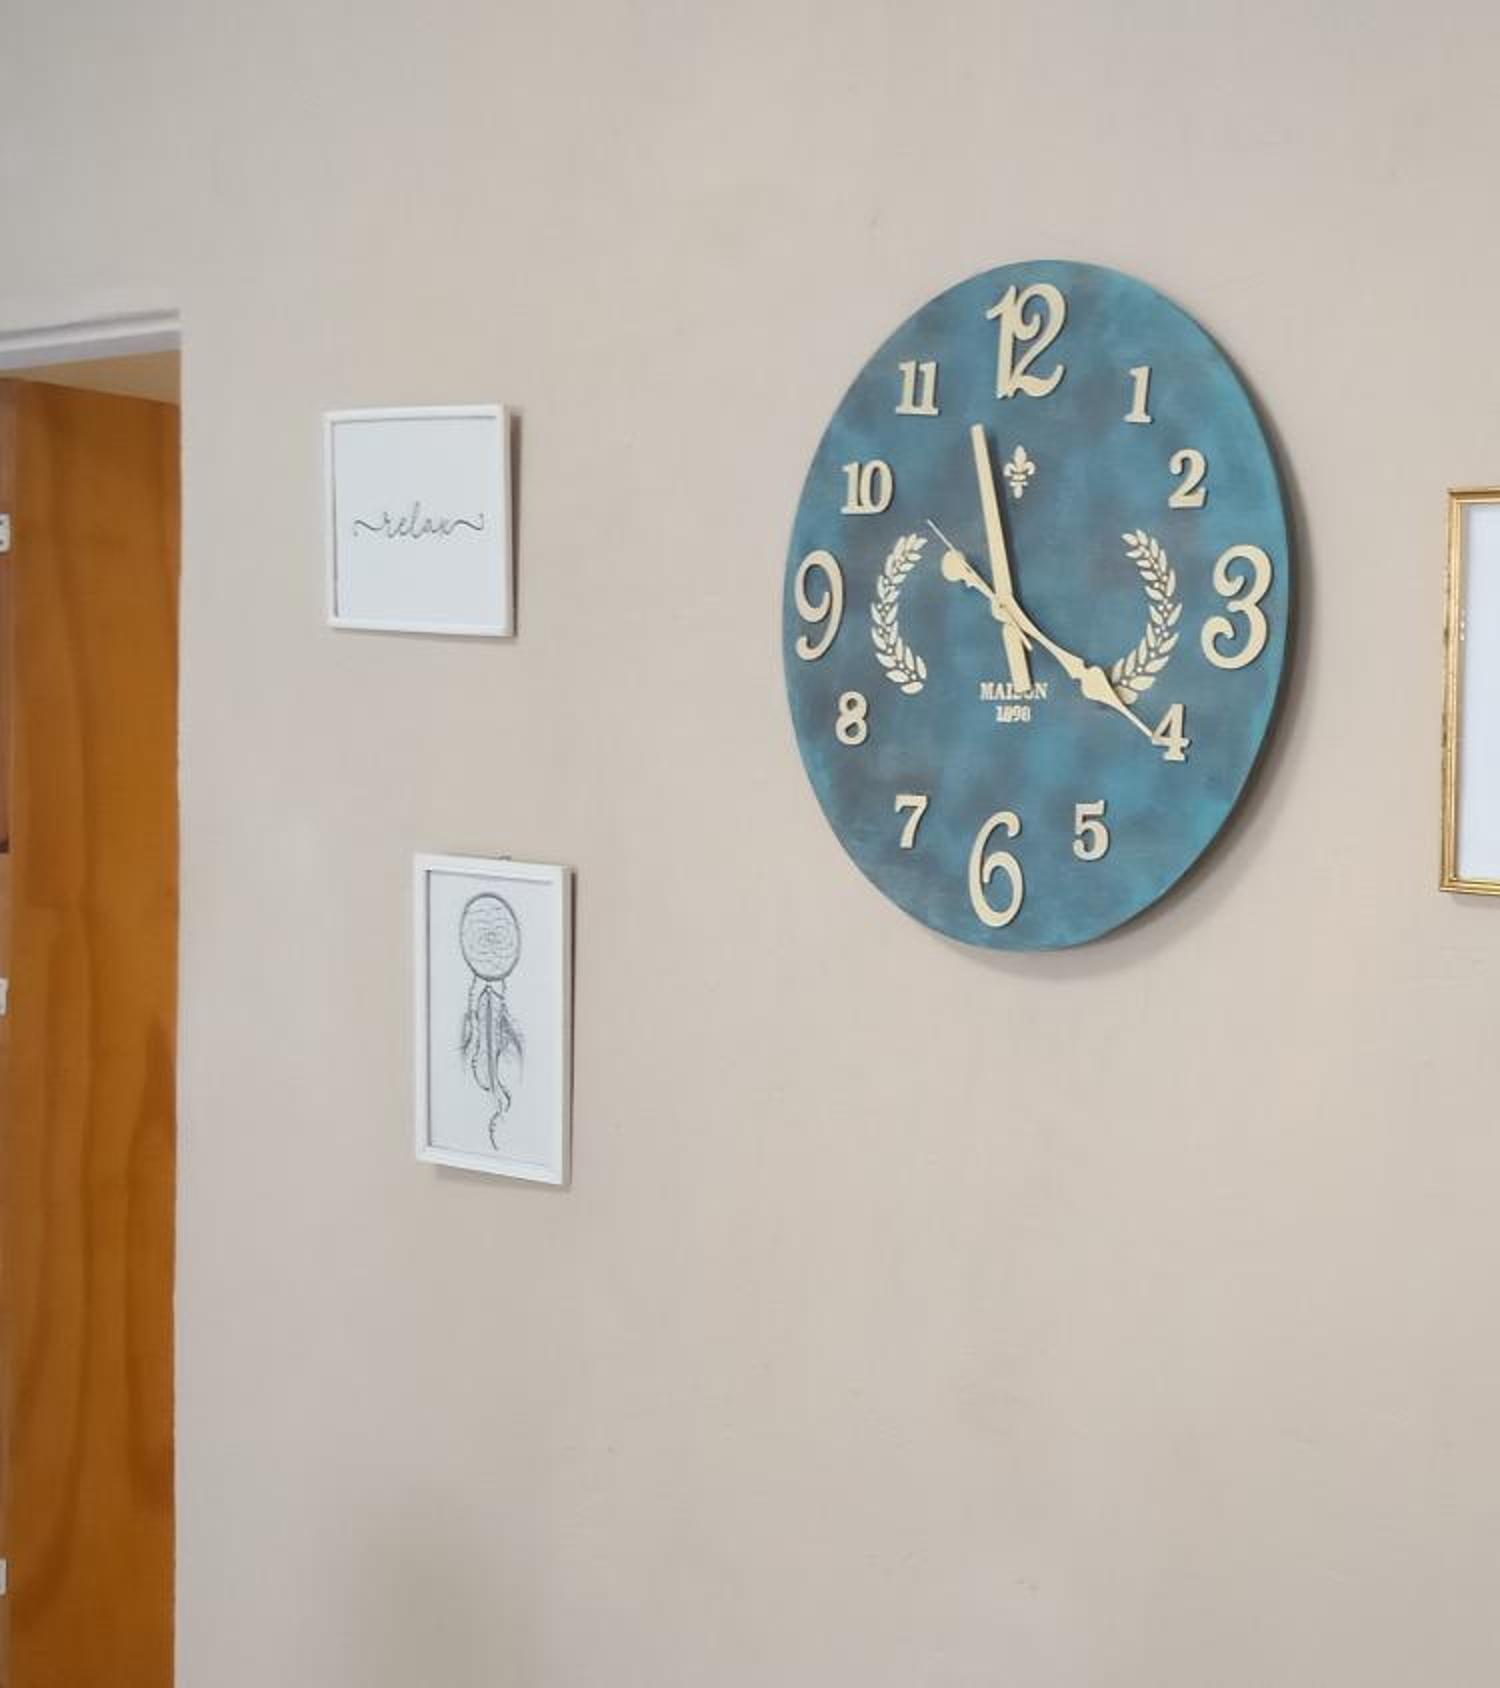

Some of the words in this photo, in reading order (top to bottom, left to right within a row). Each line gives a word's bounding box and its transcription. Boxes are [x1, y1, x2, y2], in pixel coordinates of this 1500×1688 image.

[986, 283, 1065, 399] 12
[896, 361, 938, 416] 11
[1123, 366, 1152, 424] 1
[841, 460, 892, 515] 10
[1168, 449, 1208, 508] 2
[354, 501, 485, 538] relax
[795, 549, 843, 661] 9
[1201, 544, 1272, 669] 3
[835, 691, 868, 745] 8
[1151, 703, 1190, 761] 4
[896, 795, 928, 848] 7
[1072, 800, 1110, 861] 5
[969, 811, 1024, 927] 6
